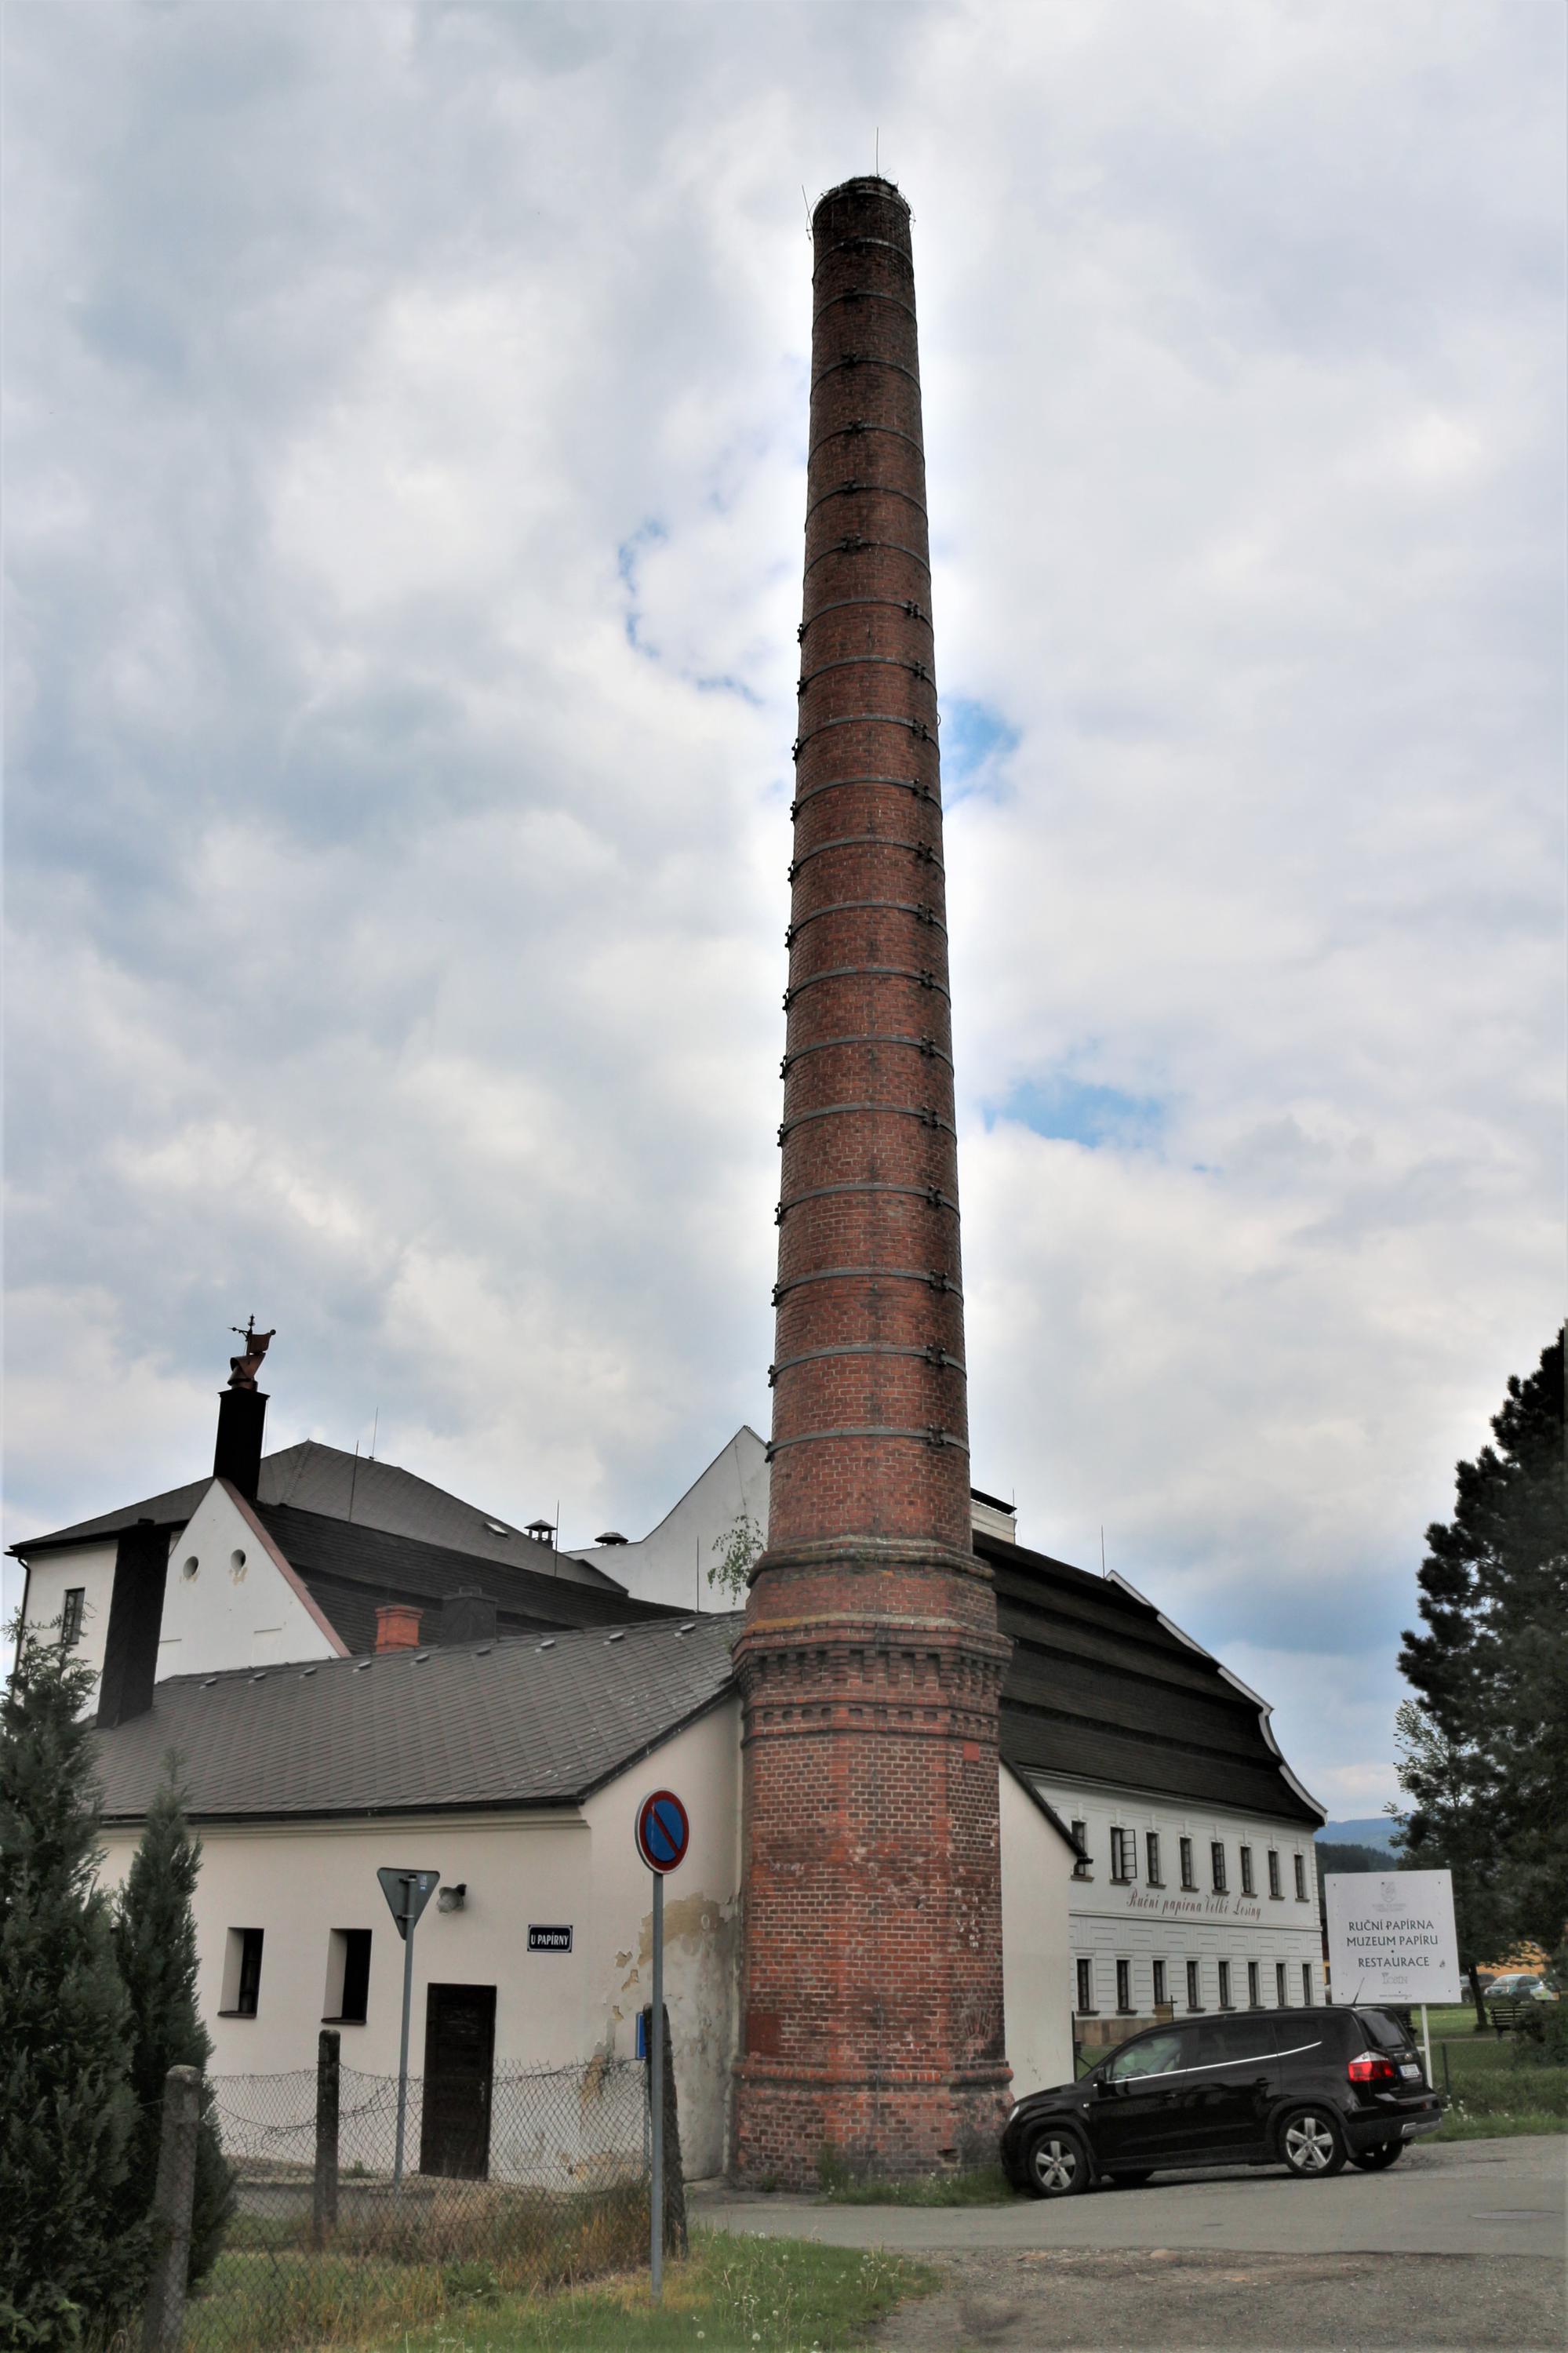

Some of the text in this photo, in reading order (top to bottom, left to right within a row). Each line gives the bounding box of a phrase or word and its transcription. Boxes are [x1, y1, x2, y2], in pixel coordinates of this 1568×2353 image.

[1348, 1918, 1434, 1931] RUČNÍ PAPÍRNA
[530, 1931, 569, 1946] U PAPÍRNY
[1347, 1933, 1438, 1947] MUZEUM PAPÍRU
[1358, 1957, 1430, 1968] RESTAURACE
